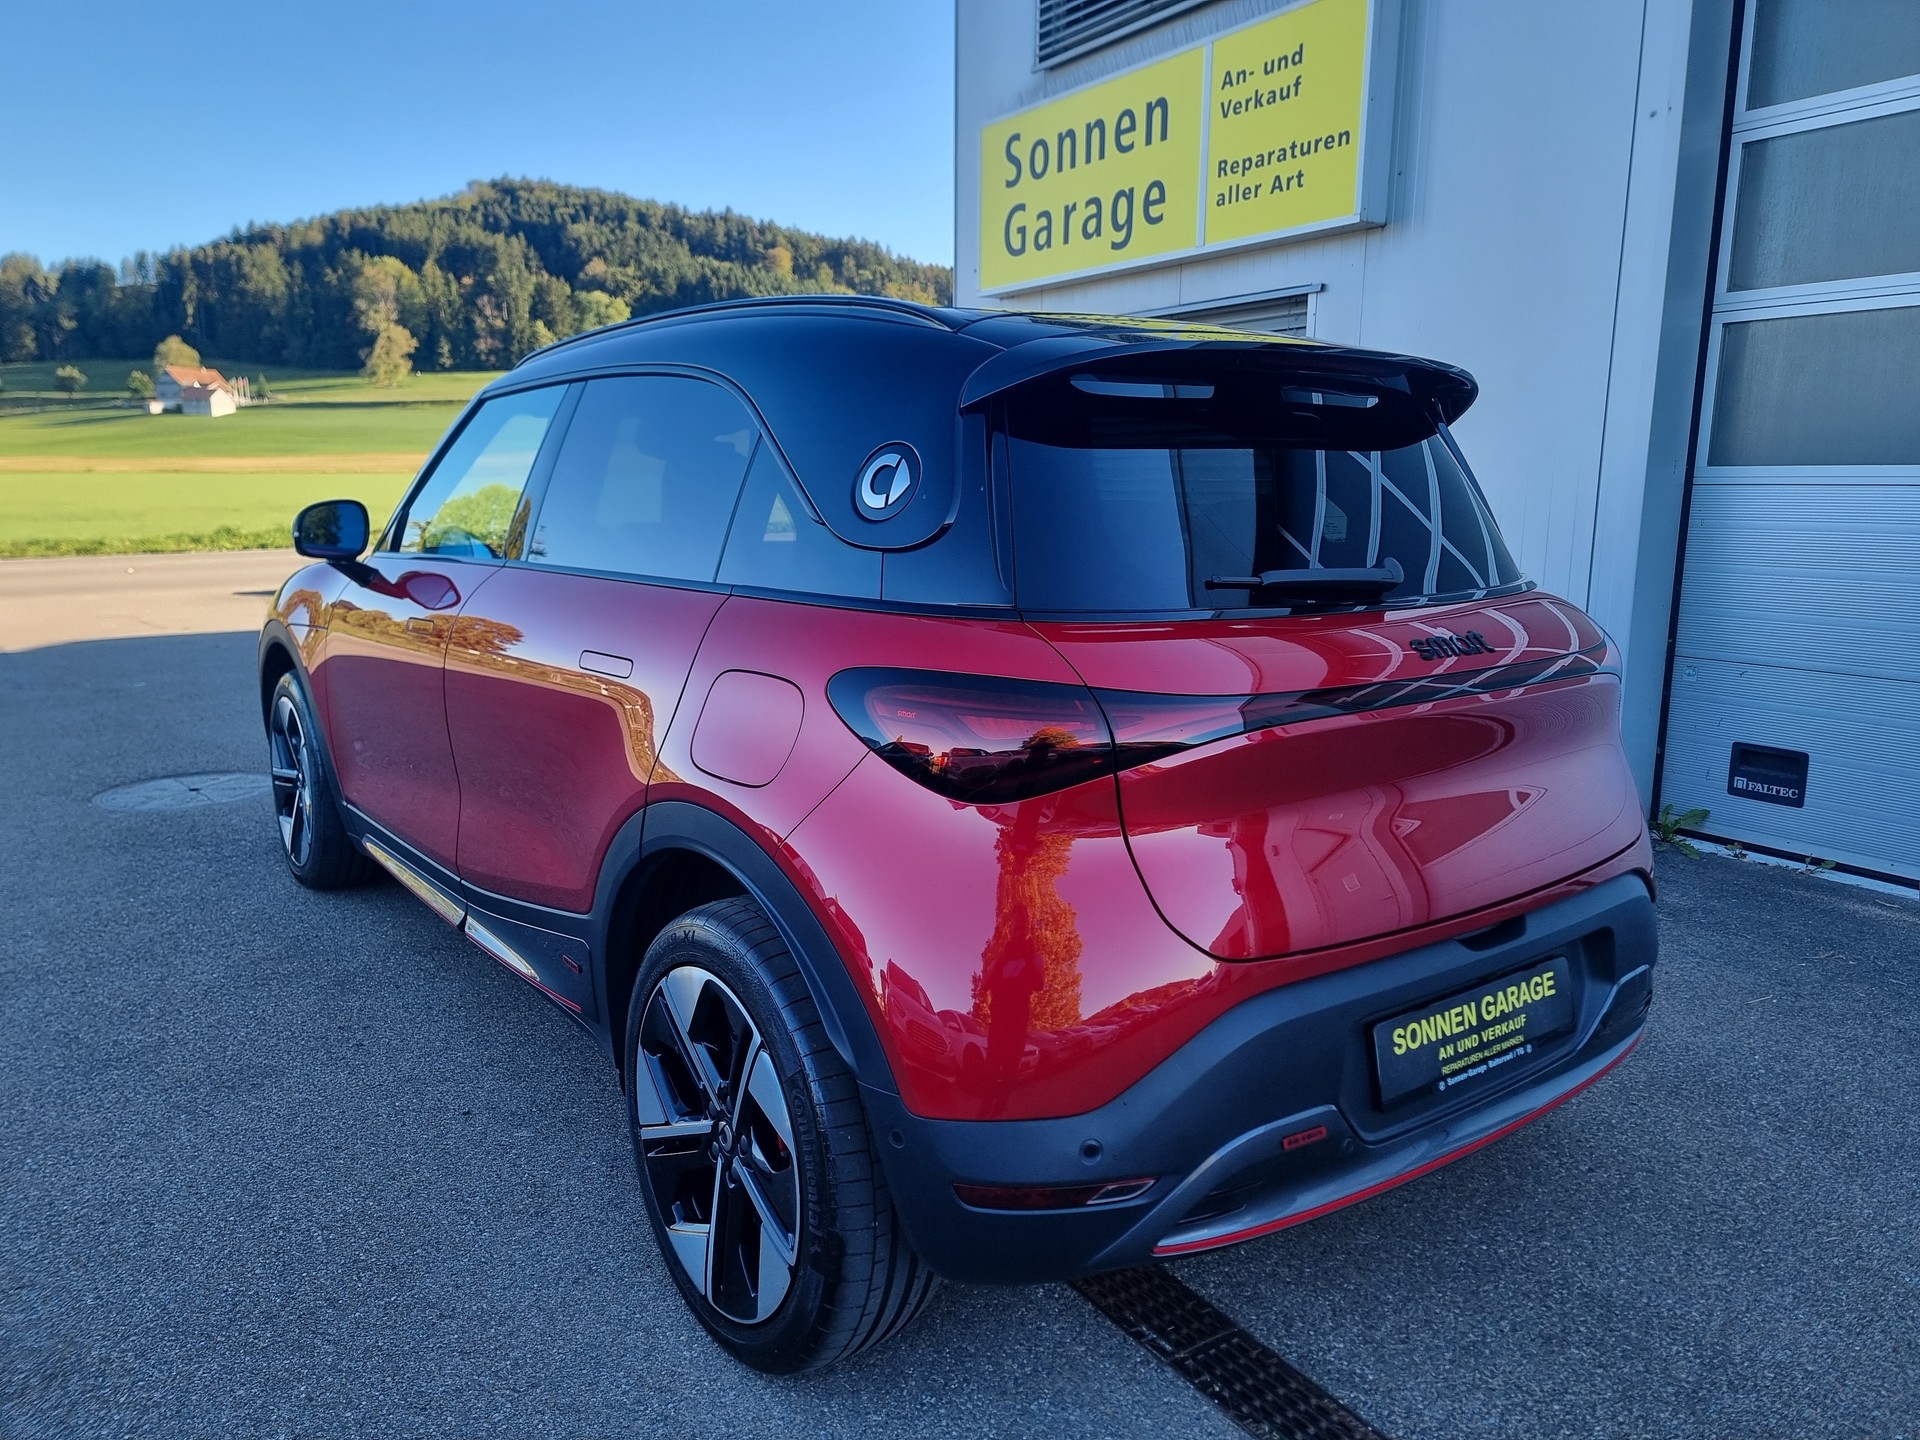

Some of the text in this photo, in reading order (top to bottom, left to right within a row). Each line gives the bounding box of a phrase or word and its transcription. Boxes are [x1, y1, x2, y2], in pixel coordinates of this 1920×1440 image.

[1220, 43, 1304, 91] An- und
[1219, 76, 1303, 120] Verkauf
[1004, 94, 1169, 190] Sonnen
[1216, 128, 1352, 179] Reparaturen
[1215, 169, 1305, 208] aller Art
[1003, 177, 1167, 258] Garage
[1408, 629, 1497, 661] smart
[896, 710, 917, 719] smart
[1747, 781, 1799, 799] FALTEC
[1392, 971, 1556, 1056] SONNEN GARAGE
[1438, 1013, 1527, 1061] AN UND VERKAUF
[1441, 1051, 1484, 1075] REPARATUREN
